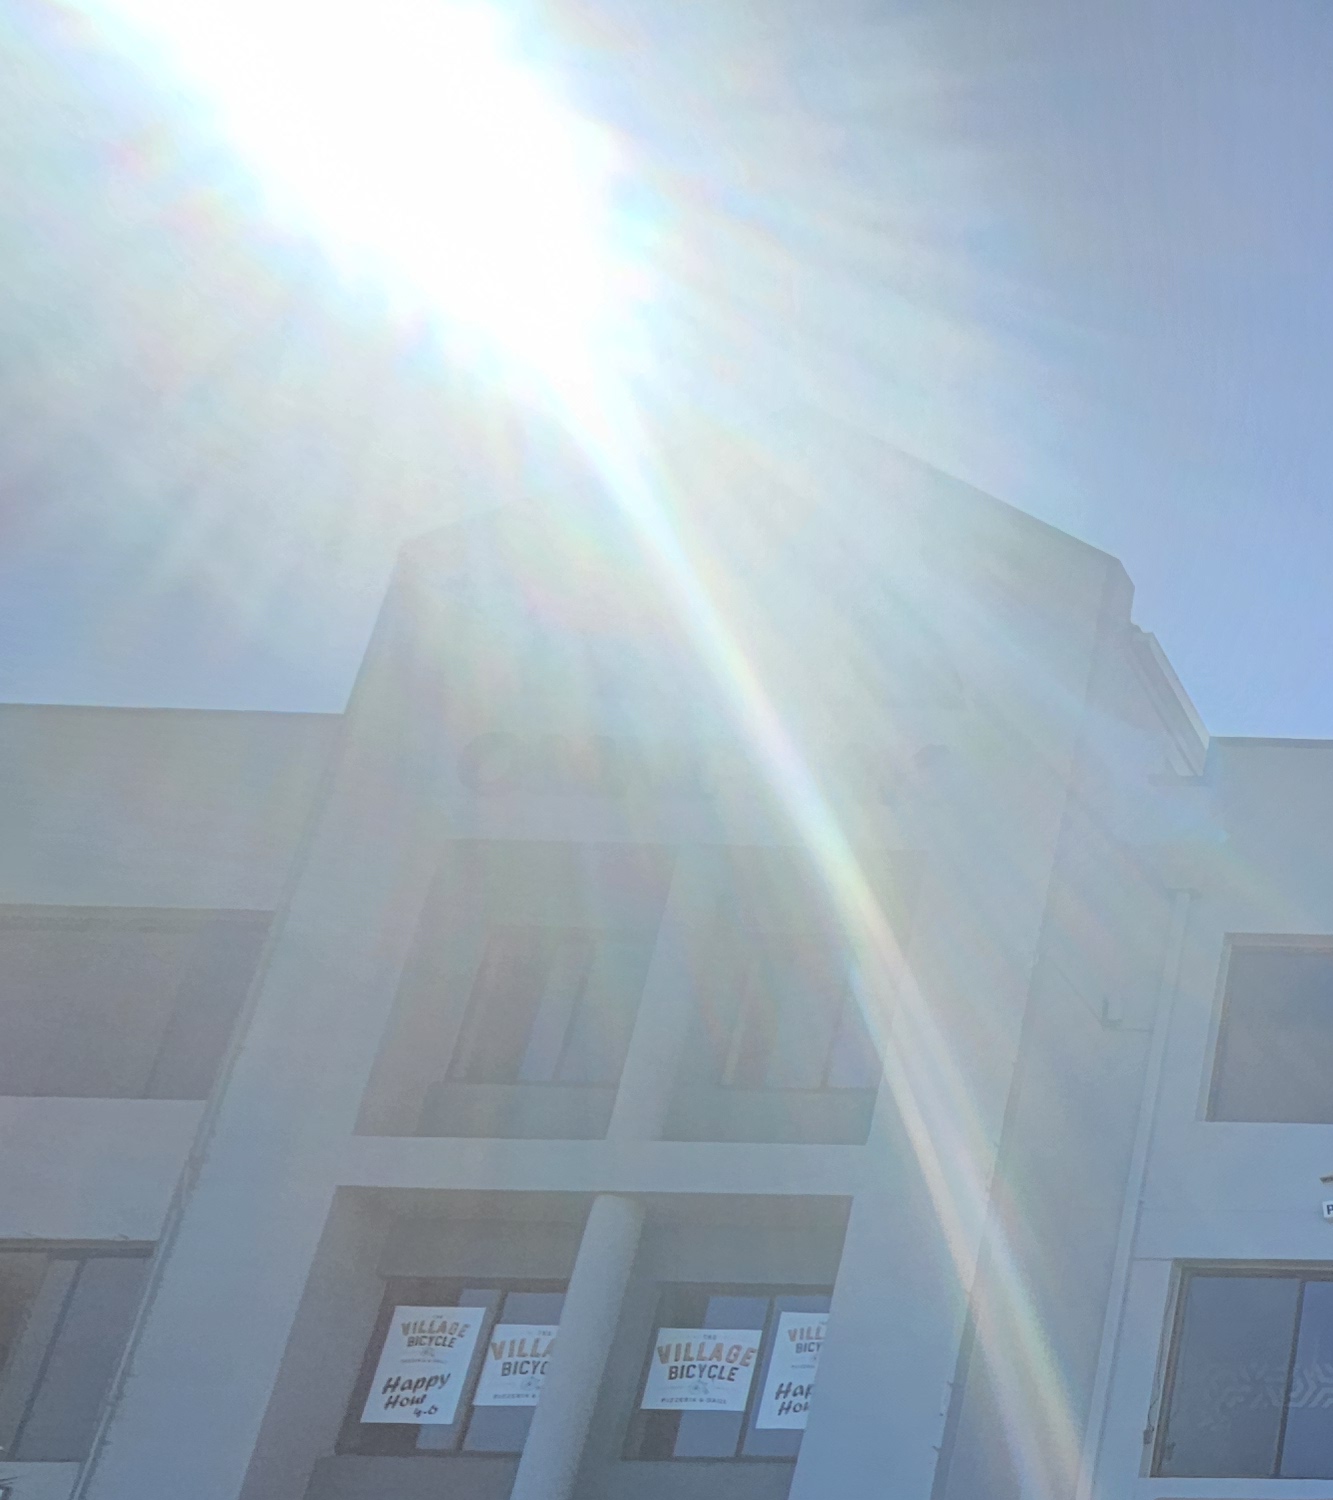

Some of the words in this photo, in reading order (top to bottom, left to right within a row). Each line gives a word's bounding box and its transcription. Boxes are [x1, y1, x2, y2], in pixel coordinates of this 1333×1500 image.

[401, 1320, 471, 1338] VILLAGE
[407, 1336, 457, 1348] BICYCLE
[795, 1342, 822, 1354] BICY
[657, 1342, 757, 1367] VILLAGE
[668, 1364, 739, 1381] BICYCLE
[382, 1373, 451, 1395] Happy
